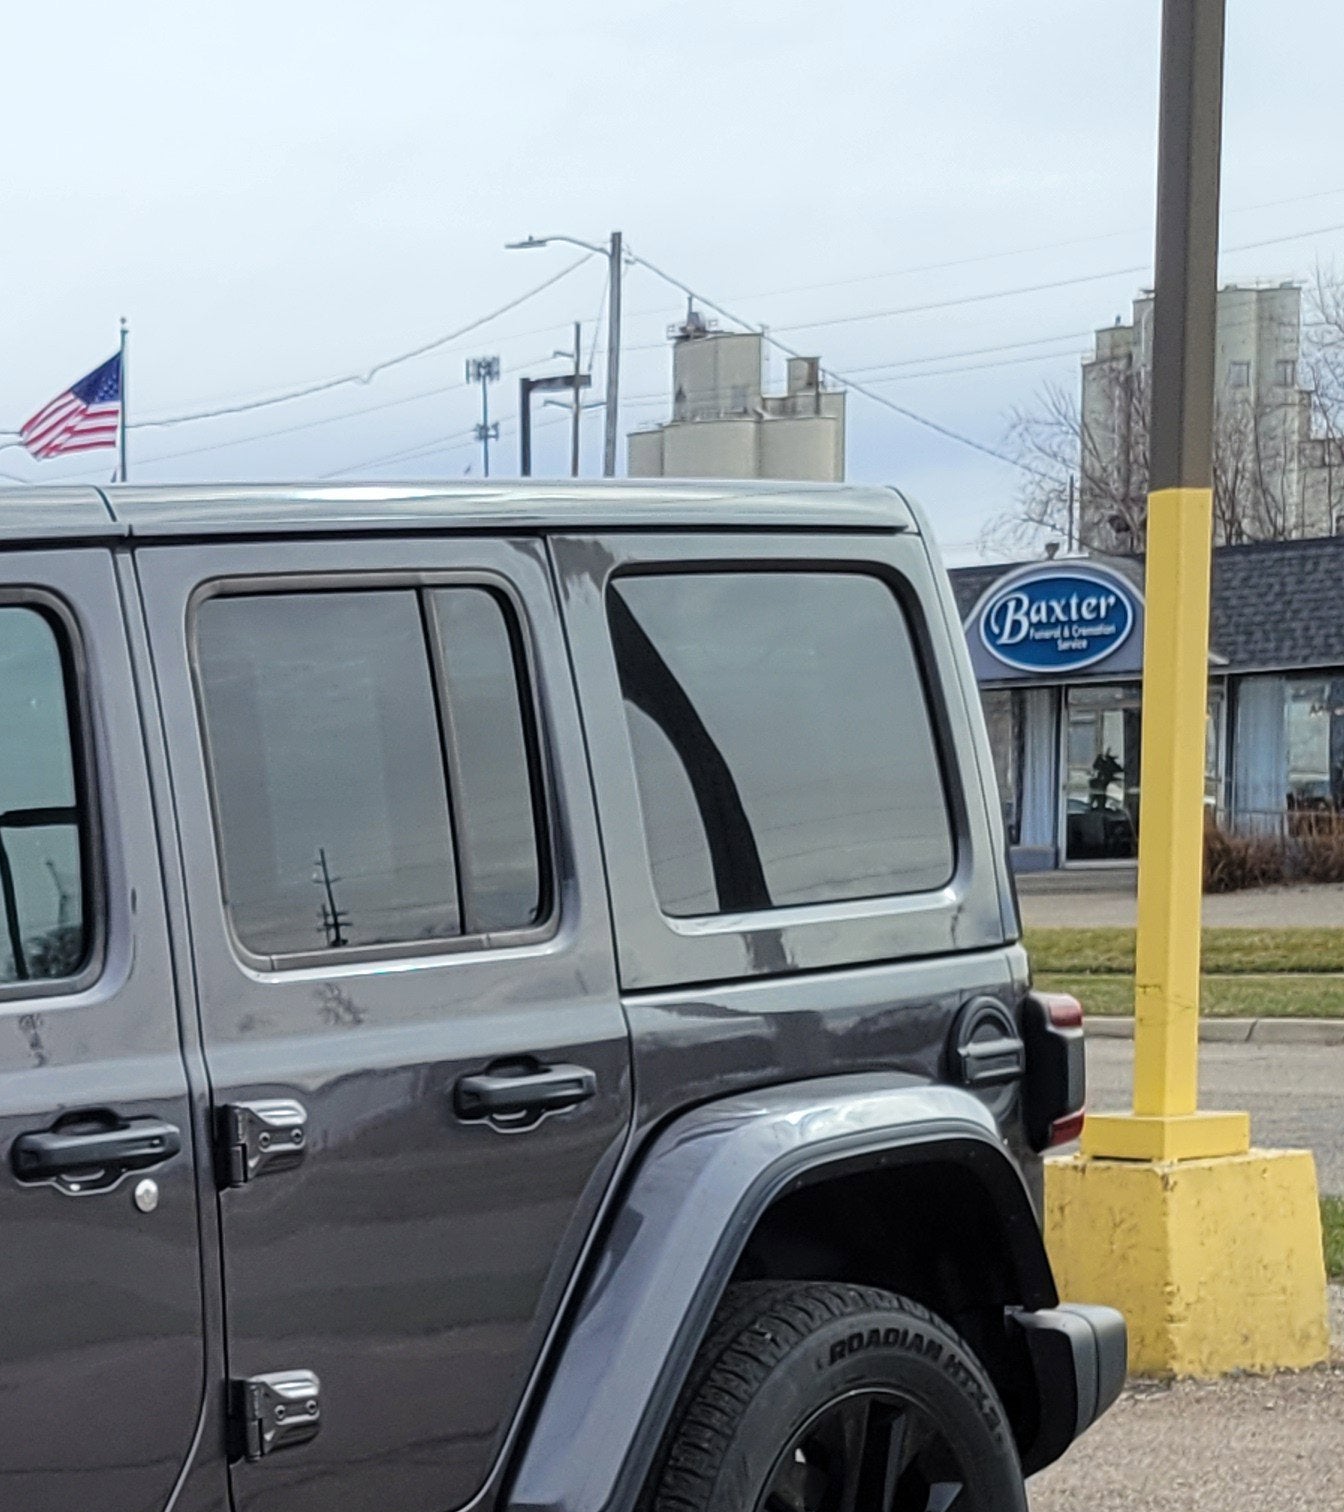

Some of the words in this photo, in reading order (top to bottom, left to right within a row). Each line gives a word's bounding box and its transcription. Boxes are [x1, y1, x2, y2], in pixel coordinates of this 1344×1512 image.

[990, 591, 1116, 645] Baxter
[1057, 638, 1088, 651] Service
[829, 1328, 944, 1366] ROADIAN
